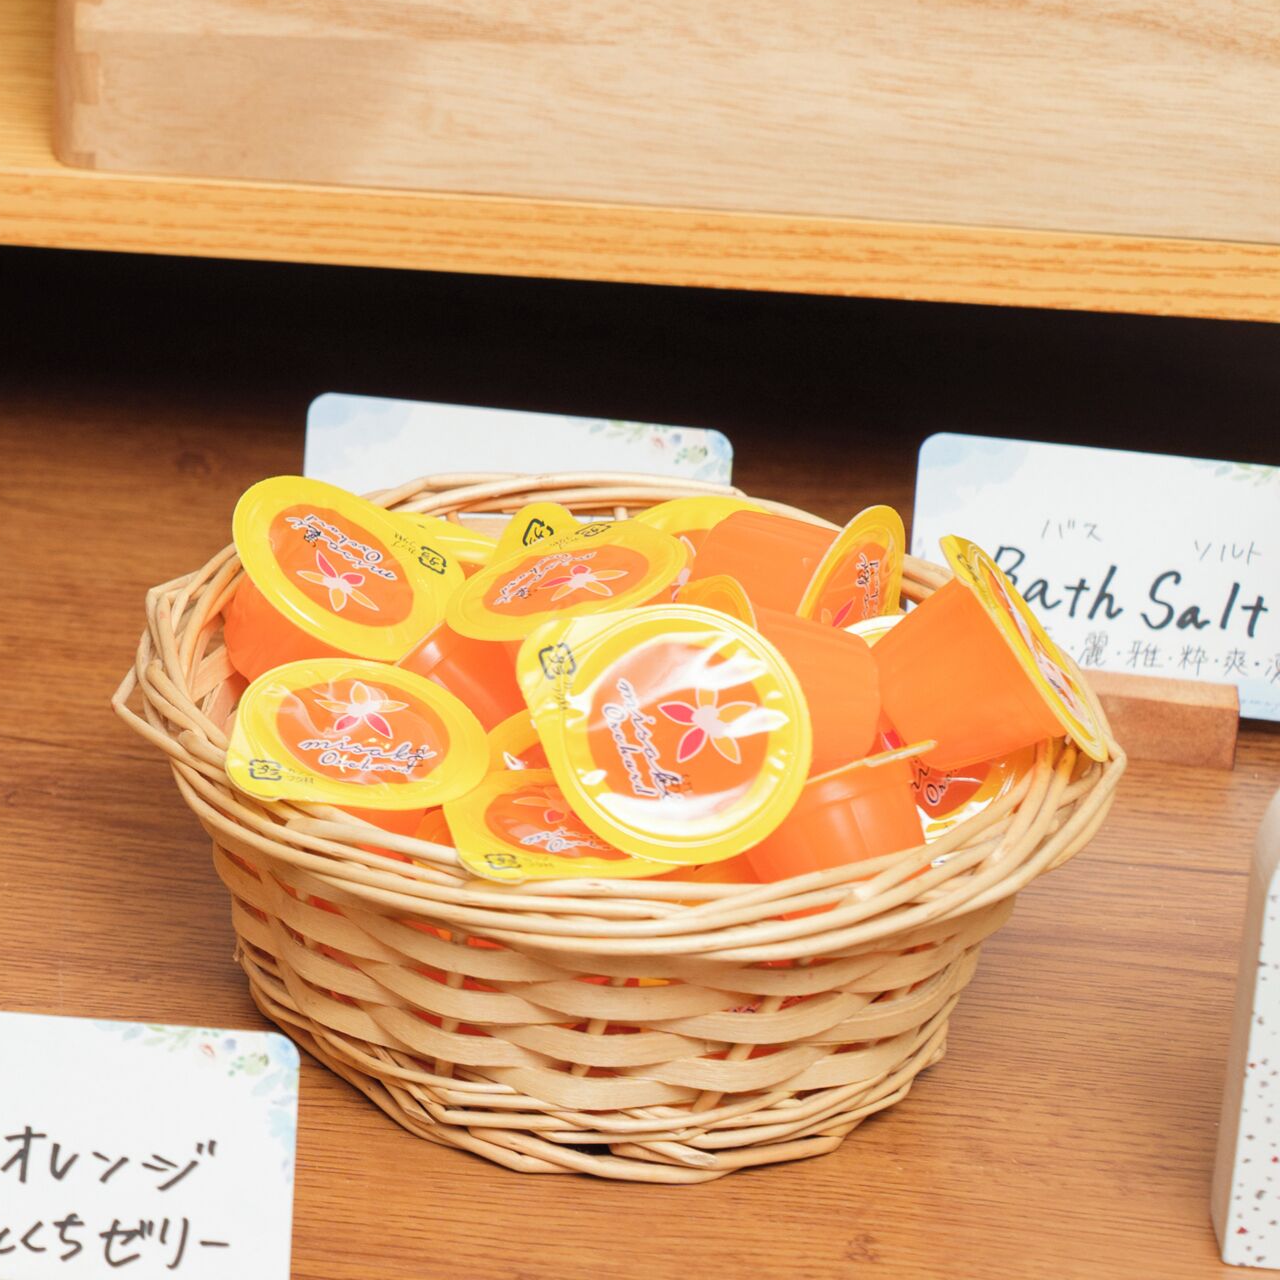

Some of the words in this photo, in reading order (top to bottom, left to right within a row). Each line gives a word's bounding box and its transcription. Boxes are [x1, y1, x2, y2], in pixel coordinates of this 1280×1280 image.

[1041, 518, 1103, 542] バス
[1194, 539, 1263, 565] ソルト
[994, 546, 1123, 621] Bath
[1141, 569, 1269, 639] Salt
